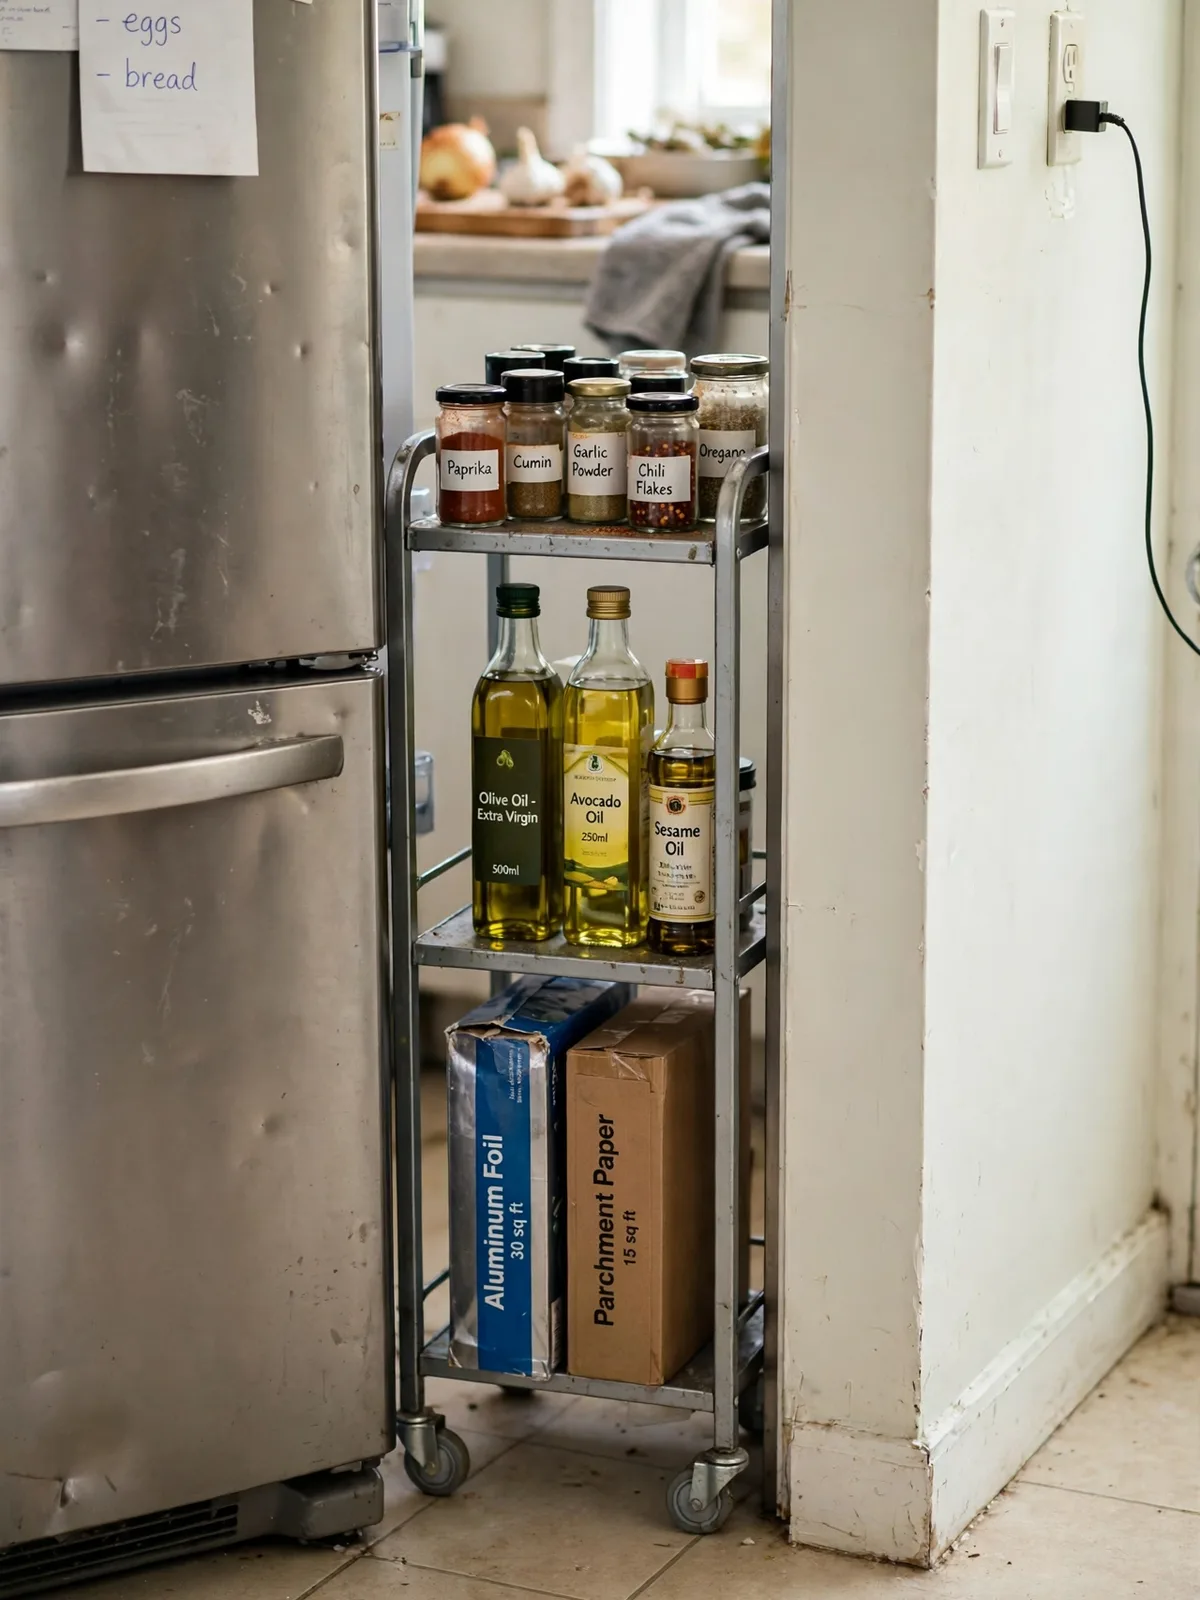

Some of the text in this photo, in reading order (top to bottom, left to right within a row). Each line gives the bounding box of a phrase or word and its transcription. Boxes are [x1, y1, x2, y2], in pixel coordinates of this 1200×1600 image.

[122, 13, 182, 46] eggs
[125, 58, 198, 91] bread
[573, 444, 608, 458] Garlic
[513, 454, 552, 469] Cumin
[572, 462, 614, 477] Powder
[447, 460, 492, 480] Paprika
[638, 463, 665, 477] Chili
[636, 481, 673, 495] Flakes
[479, 791, 508, 806] Olive
[511, 793, 528, 807] Oil
[570, 792, 622, 808] Avocado
[477, 808, 538, 826] Extra Virgin
[585, 811, 604, 824] Oil
[654, 821, 701, 837] Sesame
[581, 832, 608, 843] 250ml
[665, 841, 684, 856] Oil
[492, 864, 519, 876] 500ml
[482, 1134, 504, 1311] Aluminum Foil
[592, 1113, 620, 1326] Parchment Paper
[509, 1201, 527, 1260] 30 sq ft
[622, 1210, 639, 1266] 15 sq ft
